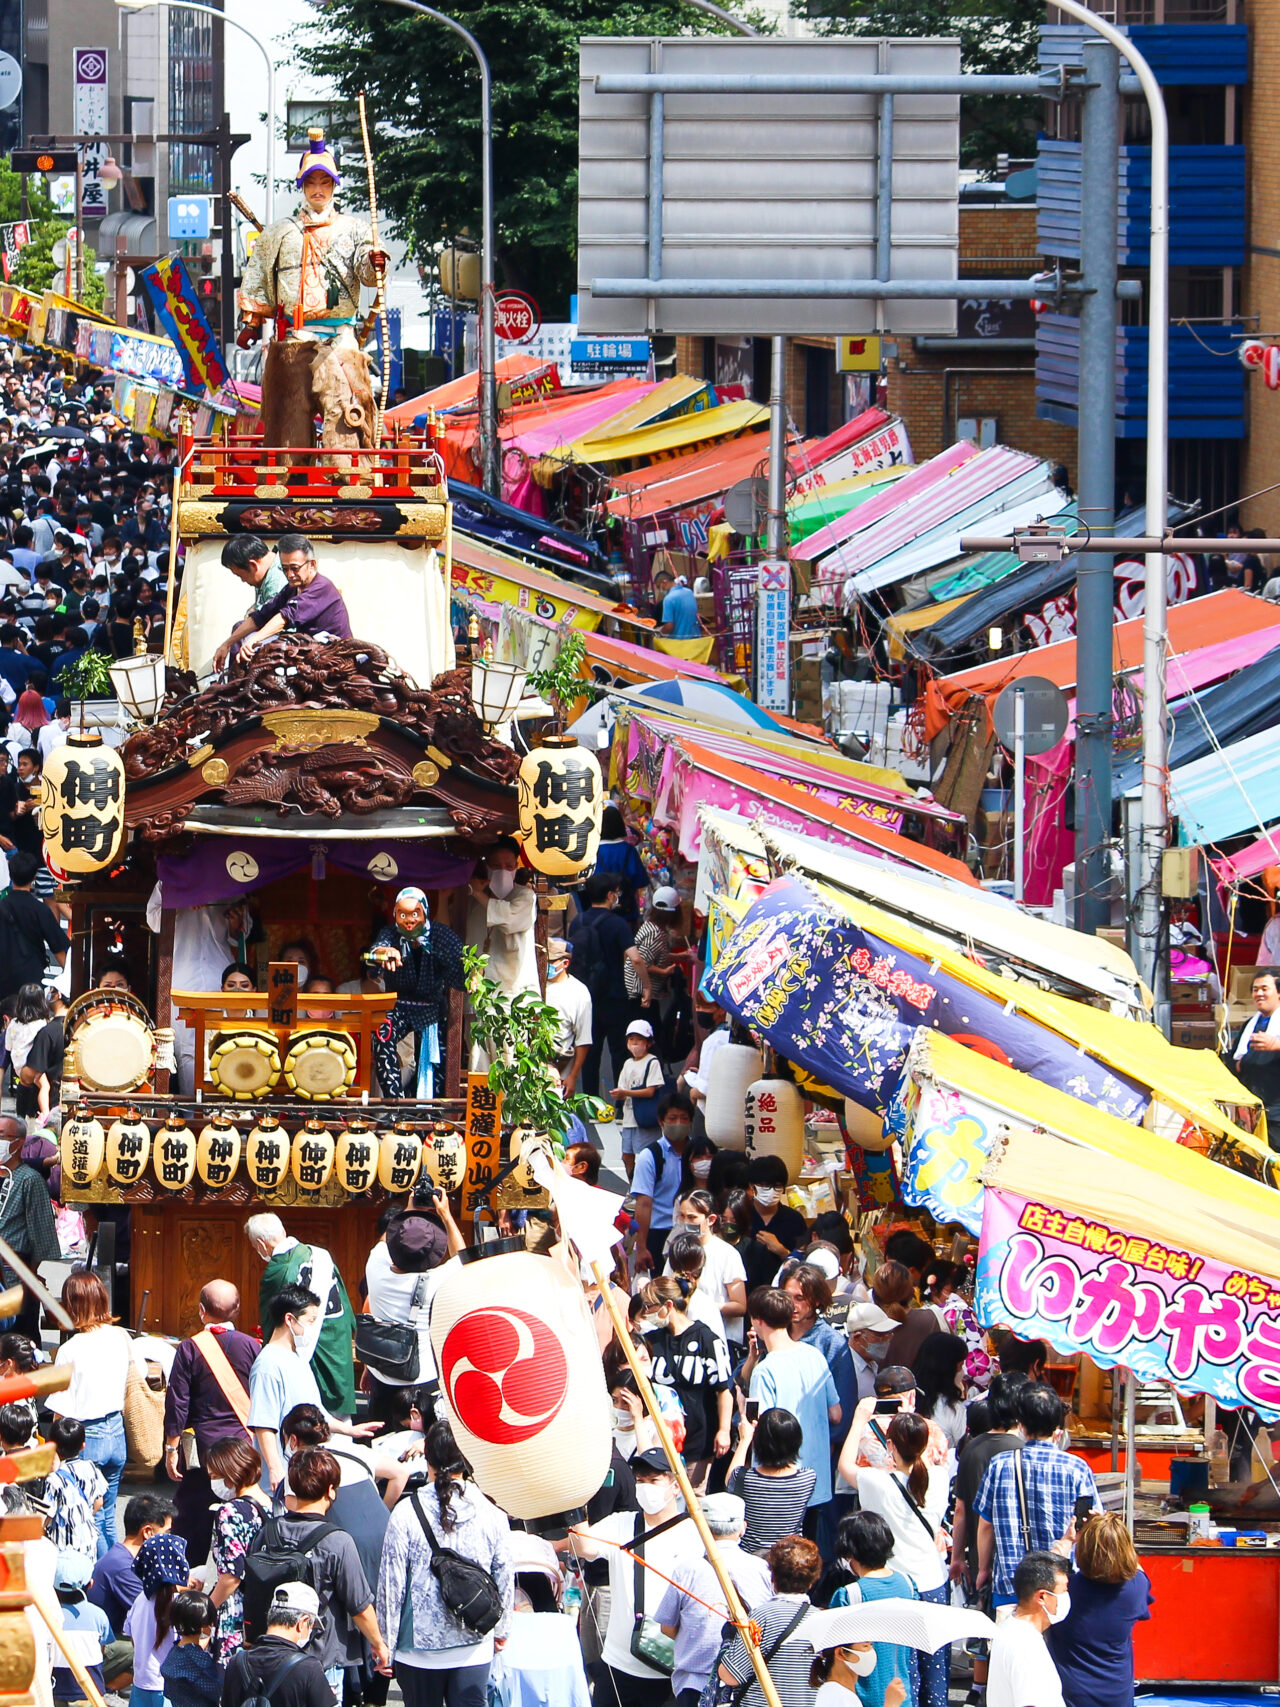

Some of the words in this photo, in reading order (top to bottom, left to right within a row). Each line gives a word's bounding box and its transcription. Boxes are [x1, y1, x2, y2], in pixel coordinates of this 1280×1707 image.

[586, 343, 633, 359] 駐輪場
[61, 757, 121, 863] 仲町
[533, 757, 595, 863] 仲町
[757, 1092, 778, 1134] 絶品
[116, 1132, 143, 1180] 仲町
[161, 1137, 189, 1185] 仲町
[206, 1136, 234, 1184] 仲町
[255, 1139, 281, 1187] 仲町
[299, 1140, 328, 1187] 仲町
[345, 1142, 372, 1192] 仲町
[390, 1142, 418, 1190] 仲町
